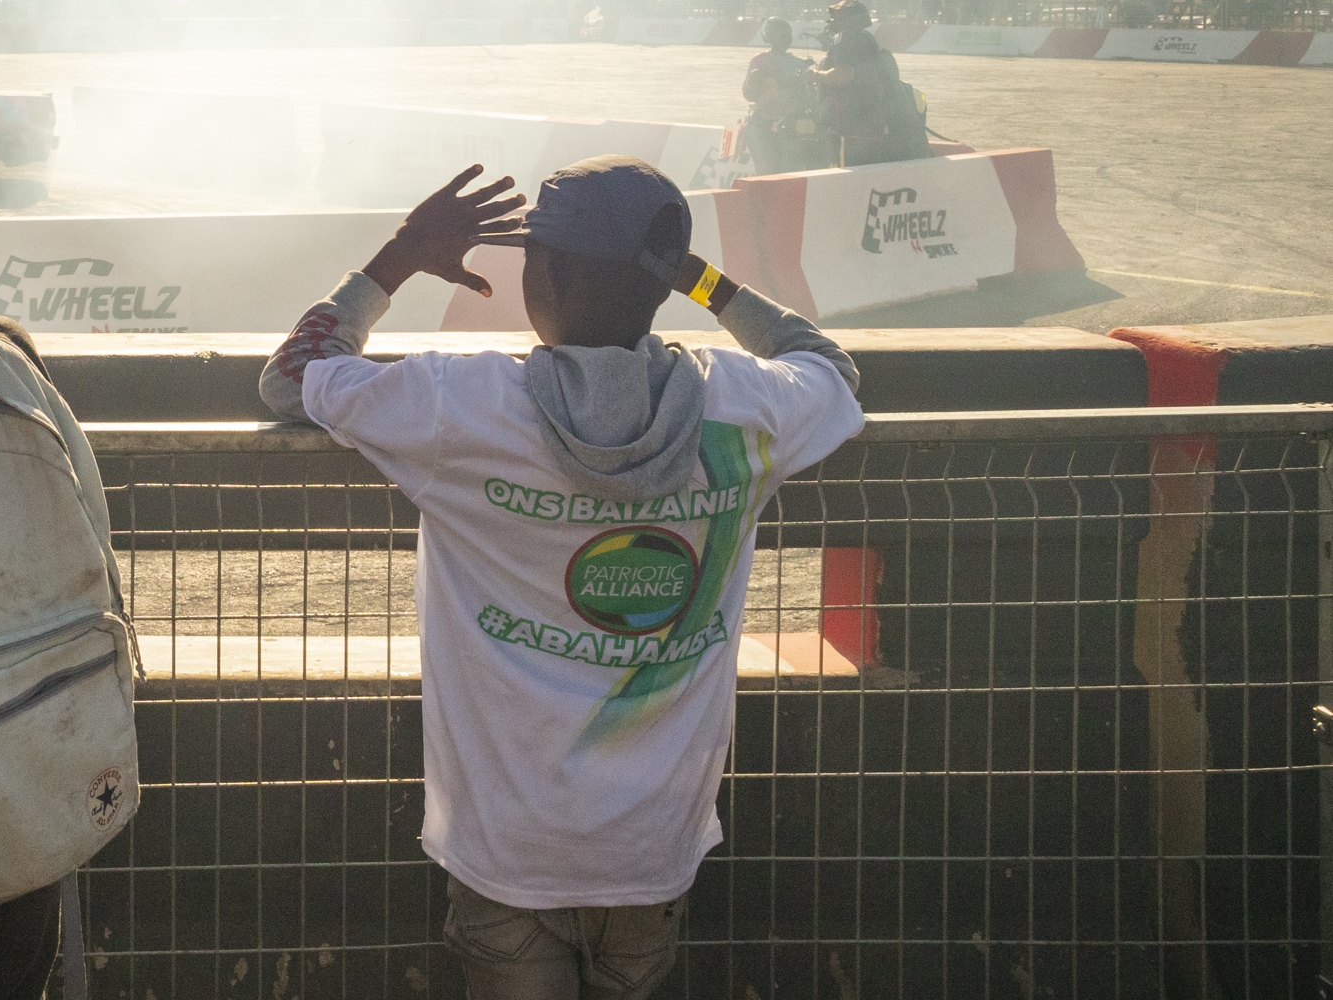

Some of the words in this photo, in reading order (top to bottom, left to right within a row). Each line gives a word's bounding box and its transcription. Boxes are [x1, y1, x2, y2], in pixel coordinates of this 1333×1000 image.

[882, 210, 947, 243] WHEELZ
[29, 286, 182, 322] WHEELZ
[484, 478, 566, 520] ONS
[690, 483, 742, 520] NIE
[580, 580, 684, 598] ALLIANCE
[583, 563, 687, 582] PATRIOTIC
[478, 606, 727, 667] #ABAHAMBE
